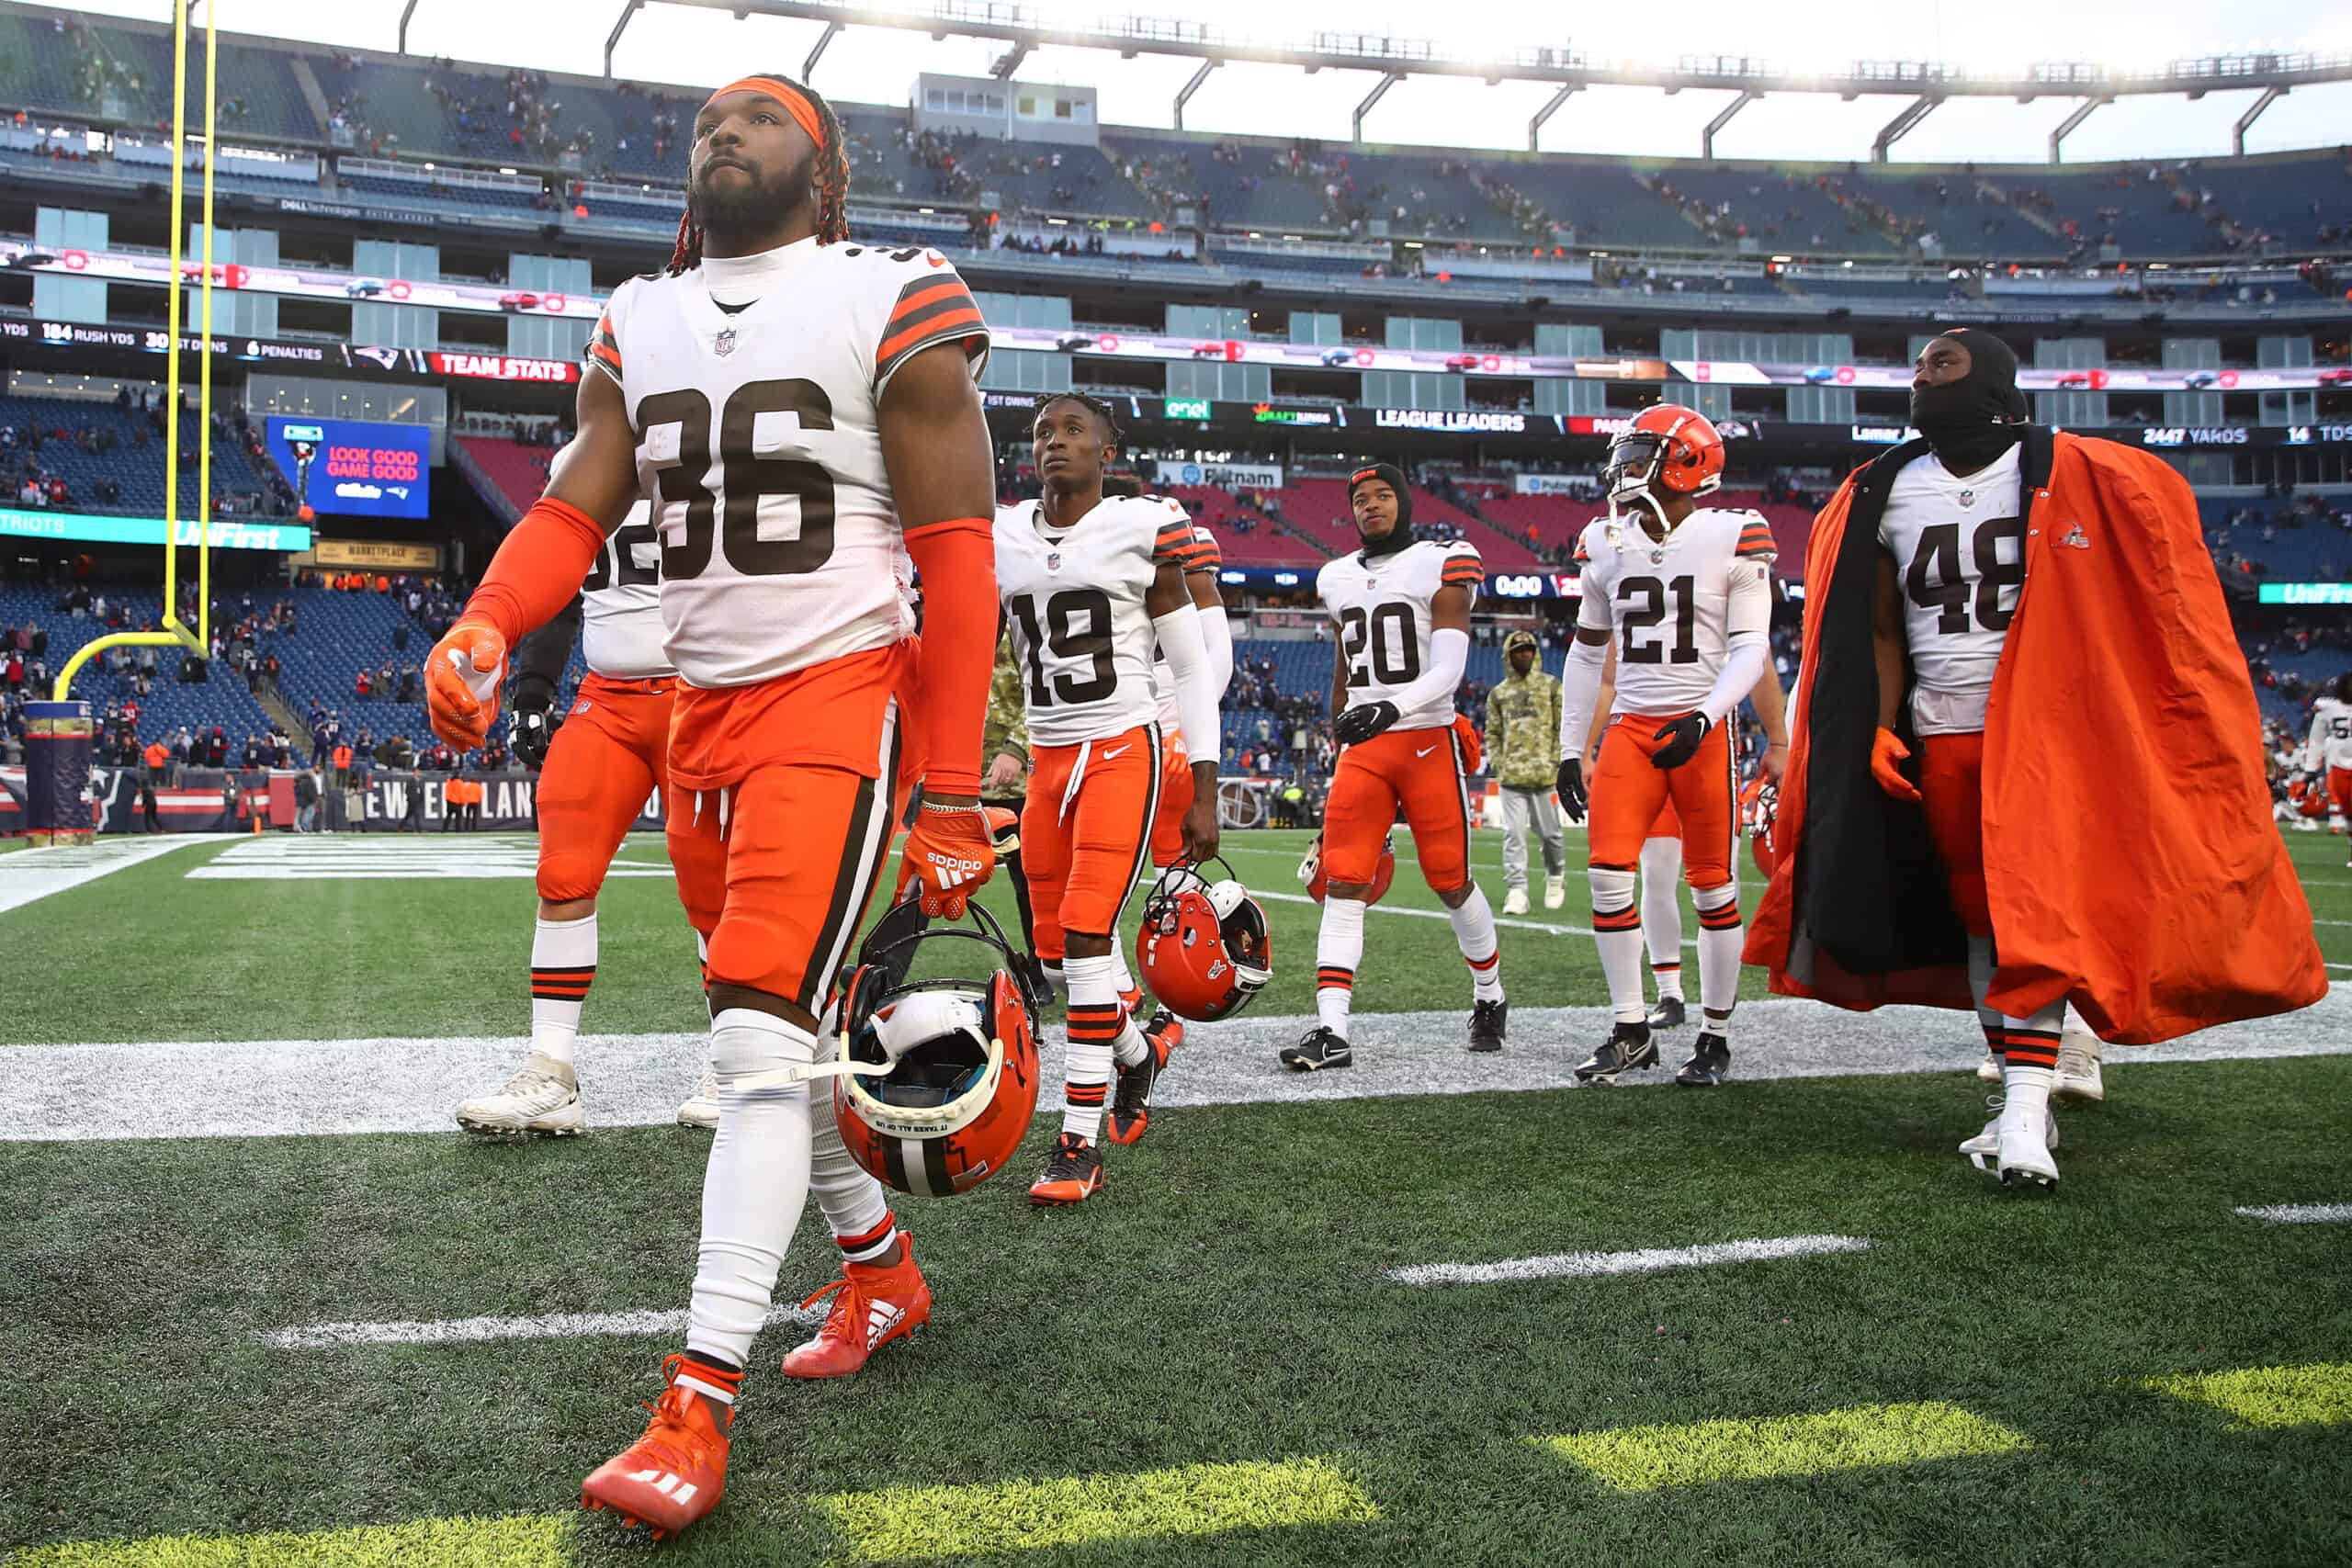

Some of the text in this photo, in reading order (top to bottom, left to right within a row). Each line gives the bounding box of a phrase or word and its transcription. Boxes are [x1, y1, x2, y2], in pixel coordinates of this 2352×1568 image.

[280, 198, 307, 211] DELL
[4, 323, 28, 337] YDS
[42, 323, 72, 340] 184
[74, 329, 108, 344] RUSH
[110, 332, 135, 345] YDS
[145, 332, 169, 349] 30
[246, 340, 260, 356] 6
[261, 344, 322, 361] PENALTIES
[440, 353, 567, 381] TEAM STATS
[1167, 400, 1208, 419] enel
[1376, 410, 1525, 433] LEAGUE LEADERS
[1852, 425, 1901, 441] Lamar
[2143, 427, 2186, 445] 2447
[2287, 426, 2310, 442] 14
[329, 446, 419, 466] LOOK GOOD
[326, 462, 419, 481] GAME GOOD
[635, 378, 835, 580] 36
[1495, 575, 1543, 596] 0:00
[1906, 516, 2022, 634] 48
[1617, 574, 1700, 663] 21
[1012, 589, 1118, 706] 19
[1340, 601, 1420, 688] 20
[367, 781, 409, 819] EW
[926, 852, 982, 872] adidas
[898, 1124, 912, 1133] ALL
[913, 1124, 938, 1133] TAKES
[866, 1306, 906, 1352] adidas
